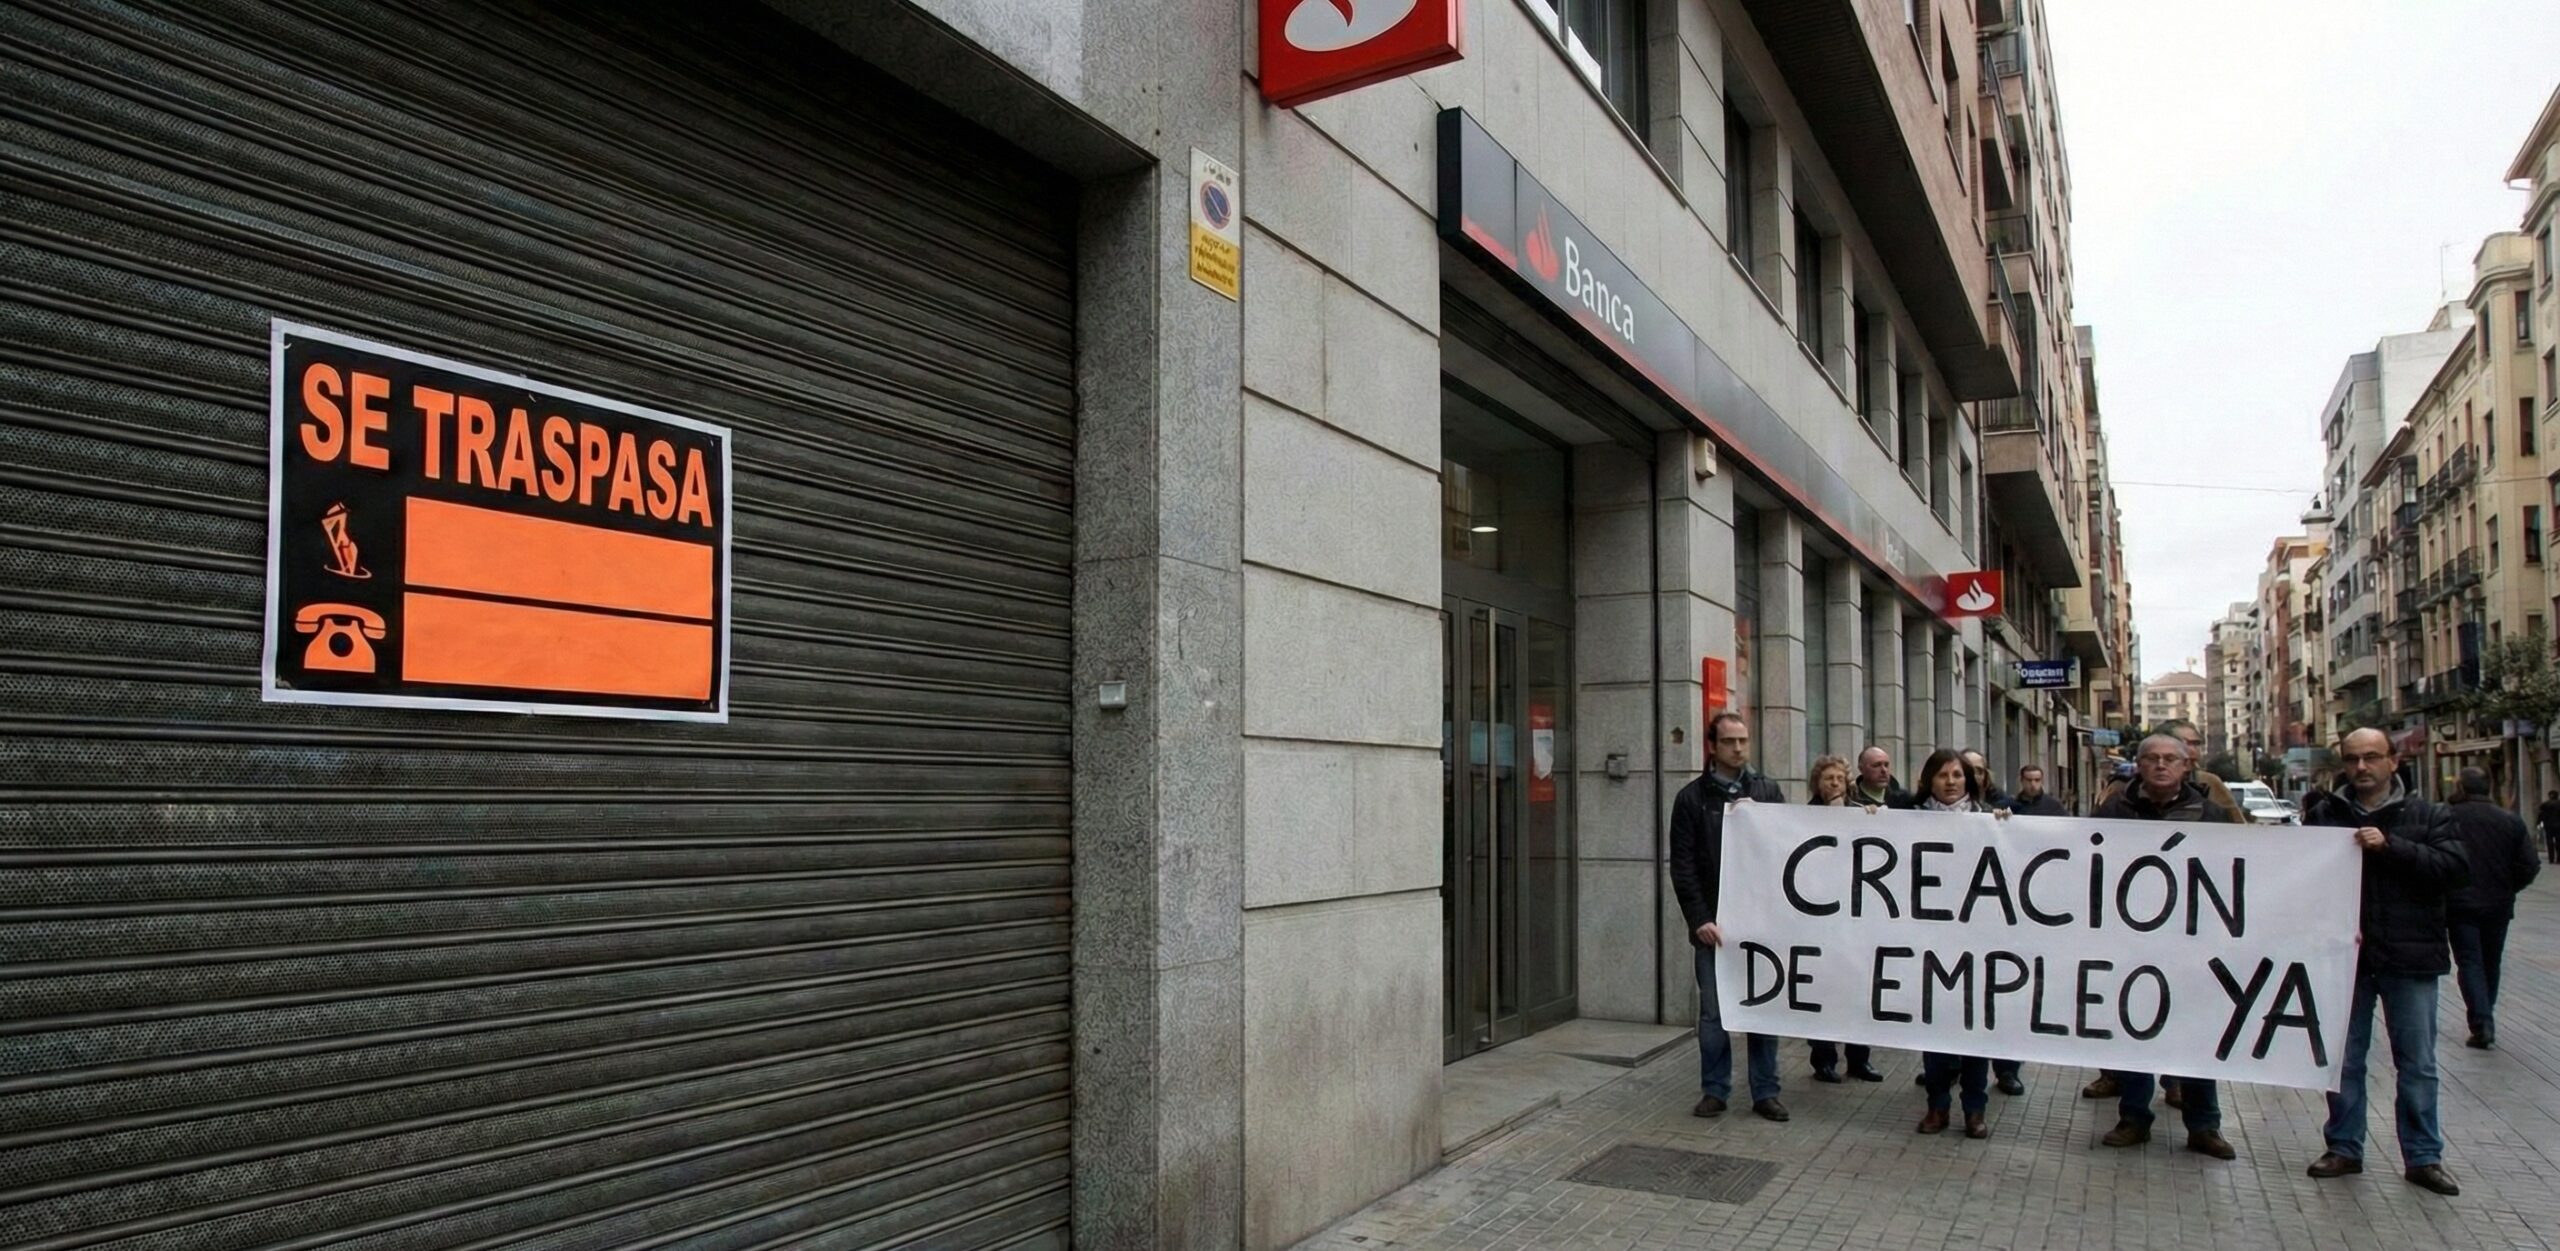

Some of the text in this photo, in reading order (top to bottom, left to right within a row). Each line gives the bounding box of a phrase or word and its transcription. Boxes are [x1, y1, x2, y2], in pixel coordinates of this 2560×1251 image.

[1565, 236, 1634, 345] Banca
[301, 363, 713, 527] SE TRASPASA
[1740, 941, 2329, 1068] DE EMPLEO YA
